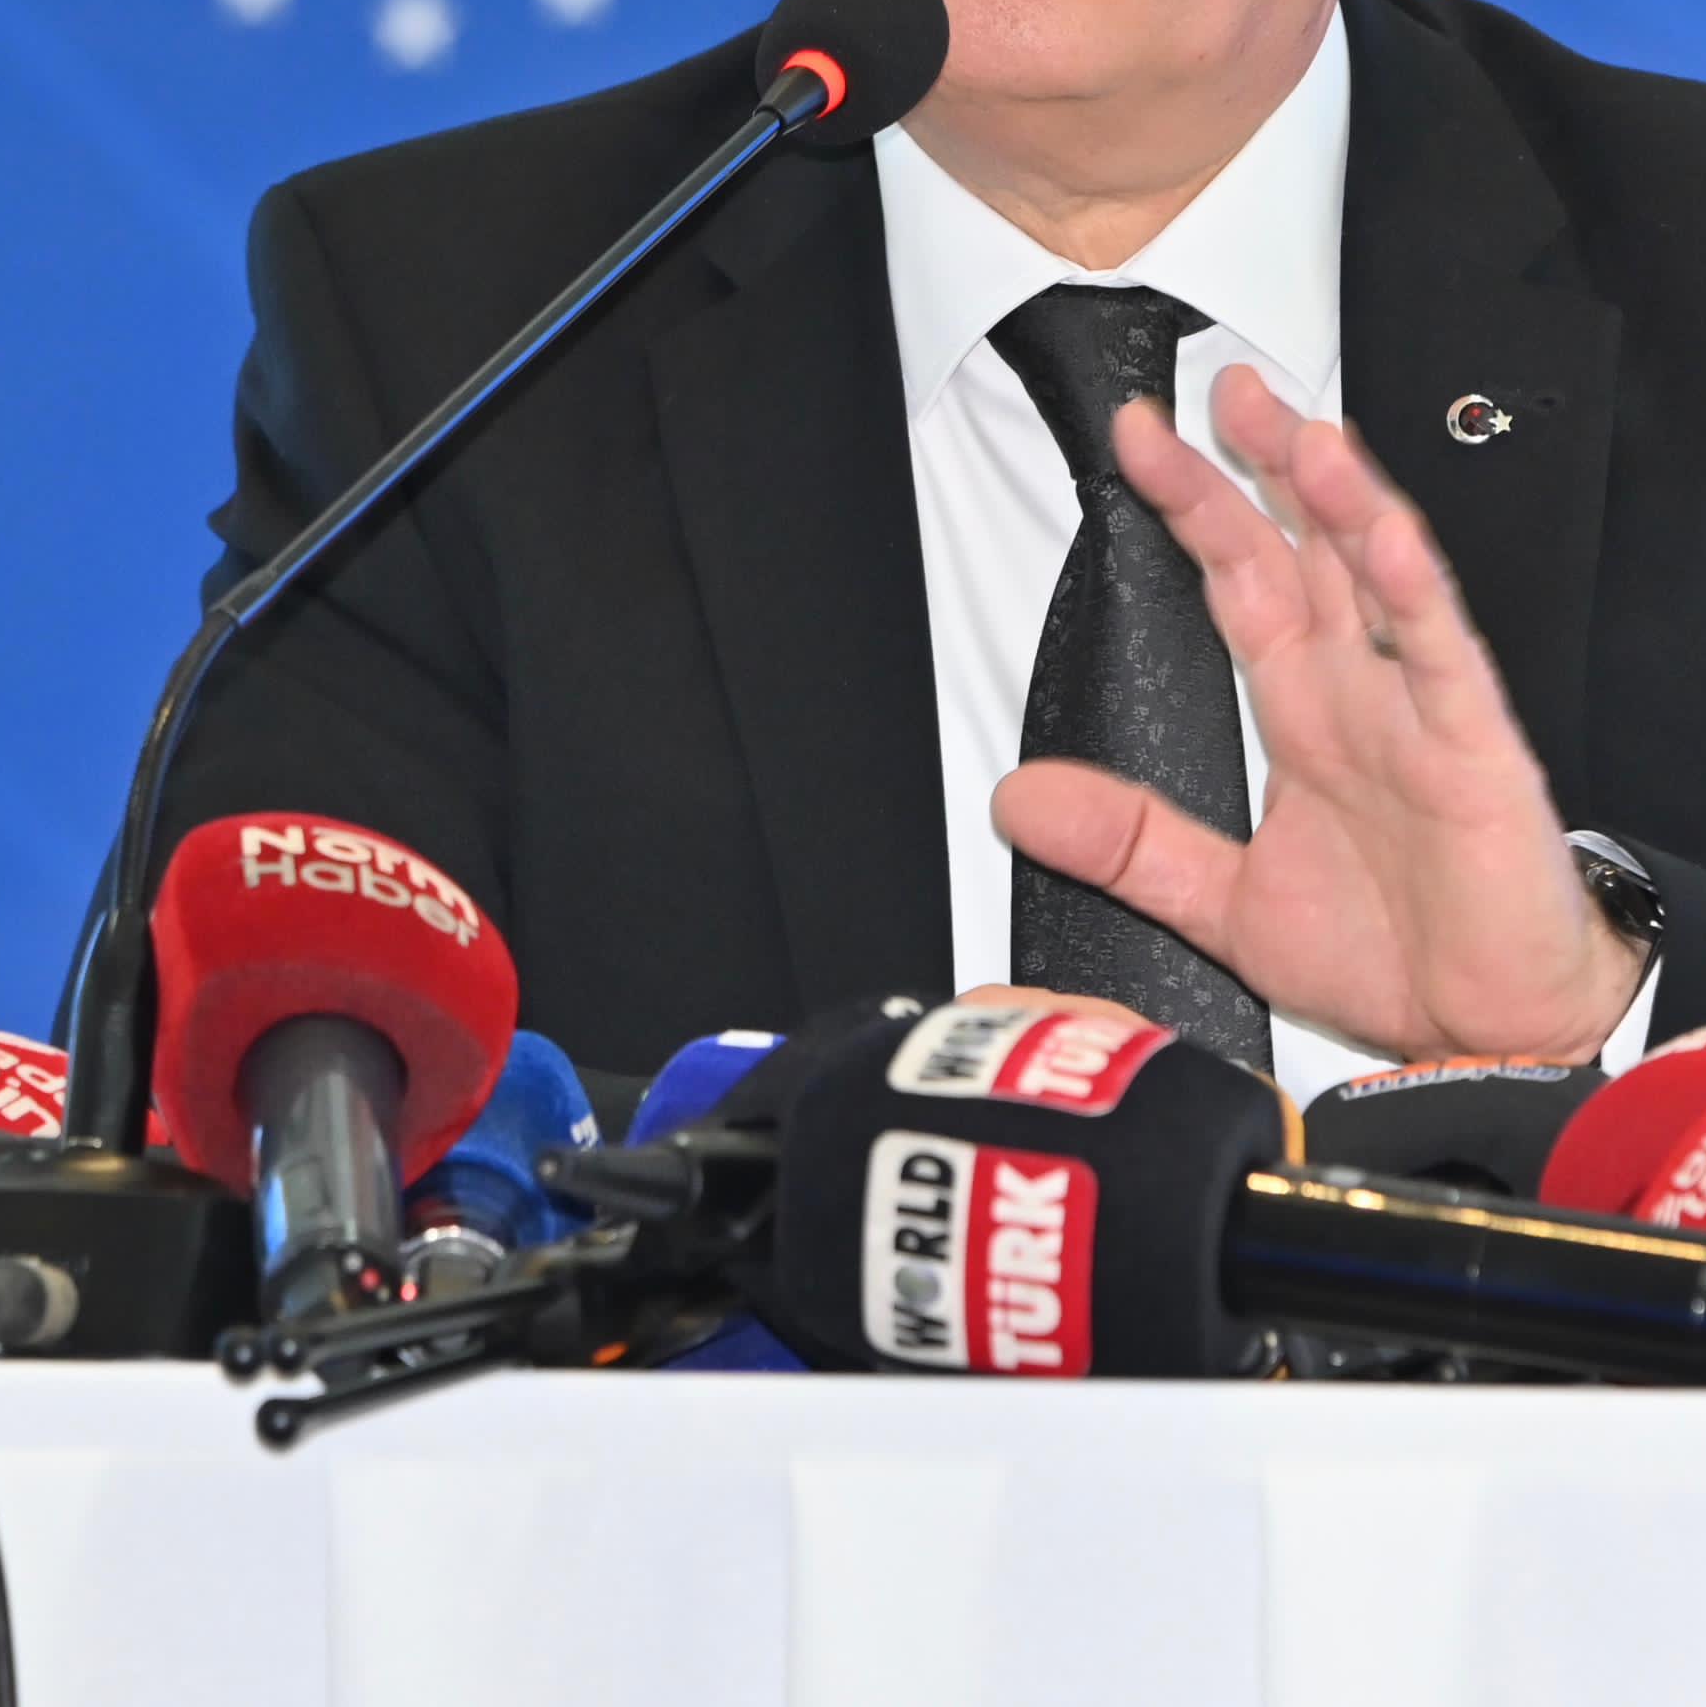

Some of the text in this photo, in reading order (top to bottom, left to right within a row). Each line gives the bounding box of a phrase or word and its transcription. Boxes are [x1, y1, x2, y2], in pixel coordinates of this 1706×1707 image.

[241, 851, 481, 948] Haber
[893, 1153, 956, 1350] WORLD
[987, 1161, 1071, 1371] TÜRK
